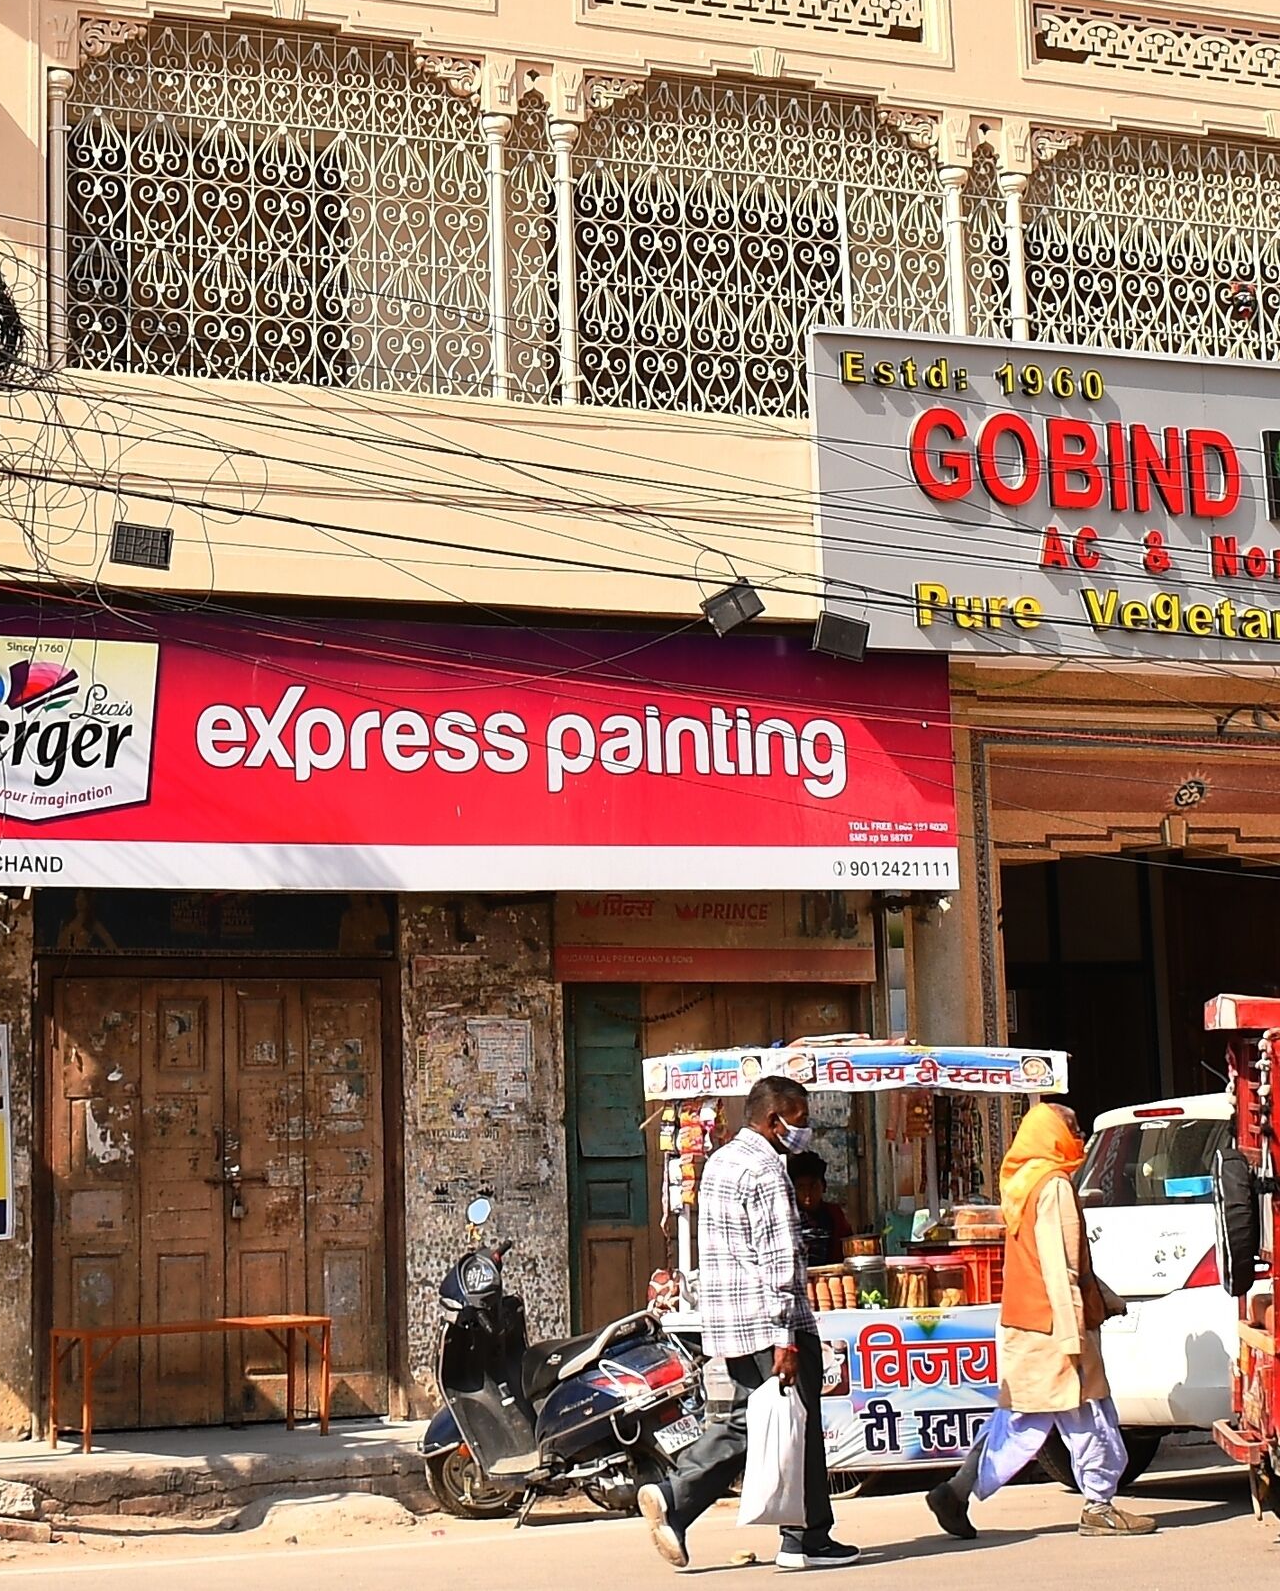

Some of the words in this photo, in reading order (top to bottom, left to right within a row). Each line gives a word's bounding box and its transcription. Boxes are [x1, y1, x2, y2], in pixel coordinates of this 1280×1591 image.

[839, 350, 968, 391] Estd:
[994, 362, 1104, 401] 1960
[908, 406, 1241, 517] GOBIND
[1039, 525, 1102, 569] AC
[1142, 529, 1171, 573] &
[913, 581, 1043, 629] Pure
[7, 641, 35, 653] Since
[38, 643, 64, 654] 1760
[69, 683, 133, 724] Lewis
[545, 704, 847, 800] painting
[29, 785, 113, 808] imagination
[849, 821, 870, 831] TOLL
[871, 821, 892, 831] FREE
[849, 833, 867, 842] SMS
[880, 833, 889, 842] to
[850, 861, 950, 877] 9012421111
[702, 903, 768, 920] PRINCE
[671, 1067, 698, 1092] विजय
[702, 1064, 712, 1090] टी
[714, 1069, 738, 1088] स्टाल
[826, 1058, 906, 1083] विजय
[916, 1058, 939, 1083] टी
[948, 1067, 1014, 1084] स्टाल
[857, 1323, 998, 1390] विजय
[859, 1400, 901, 1451] टी
